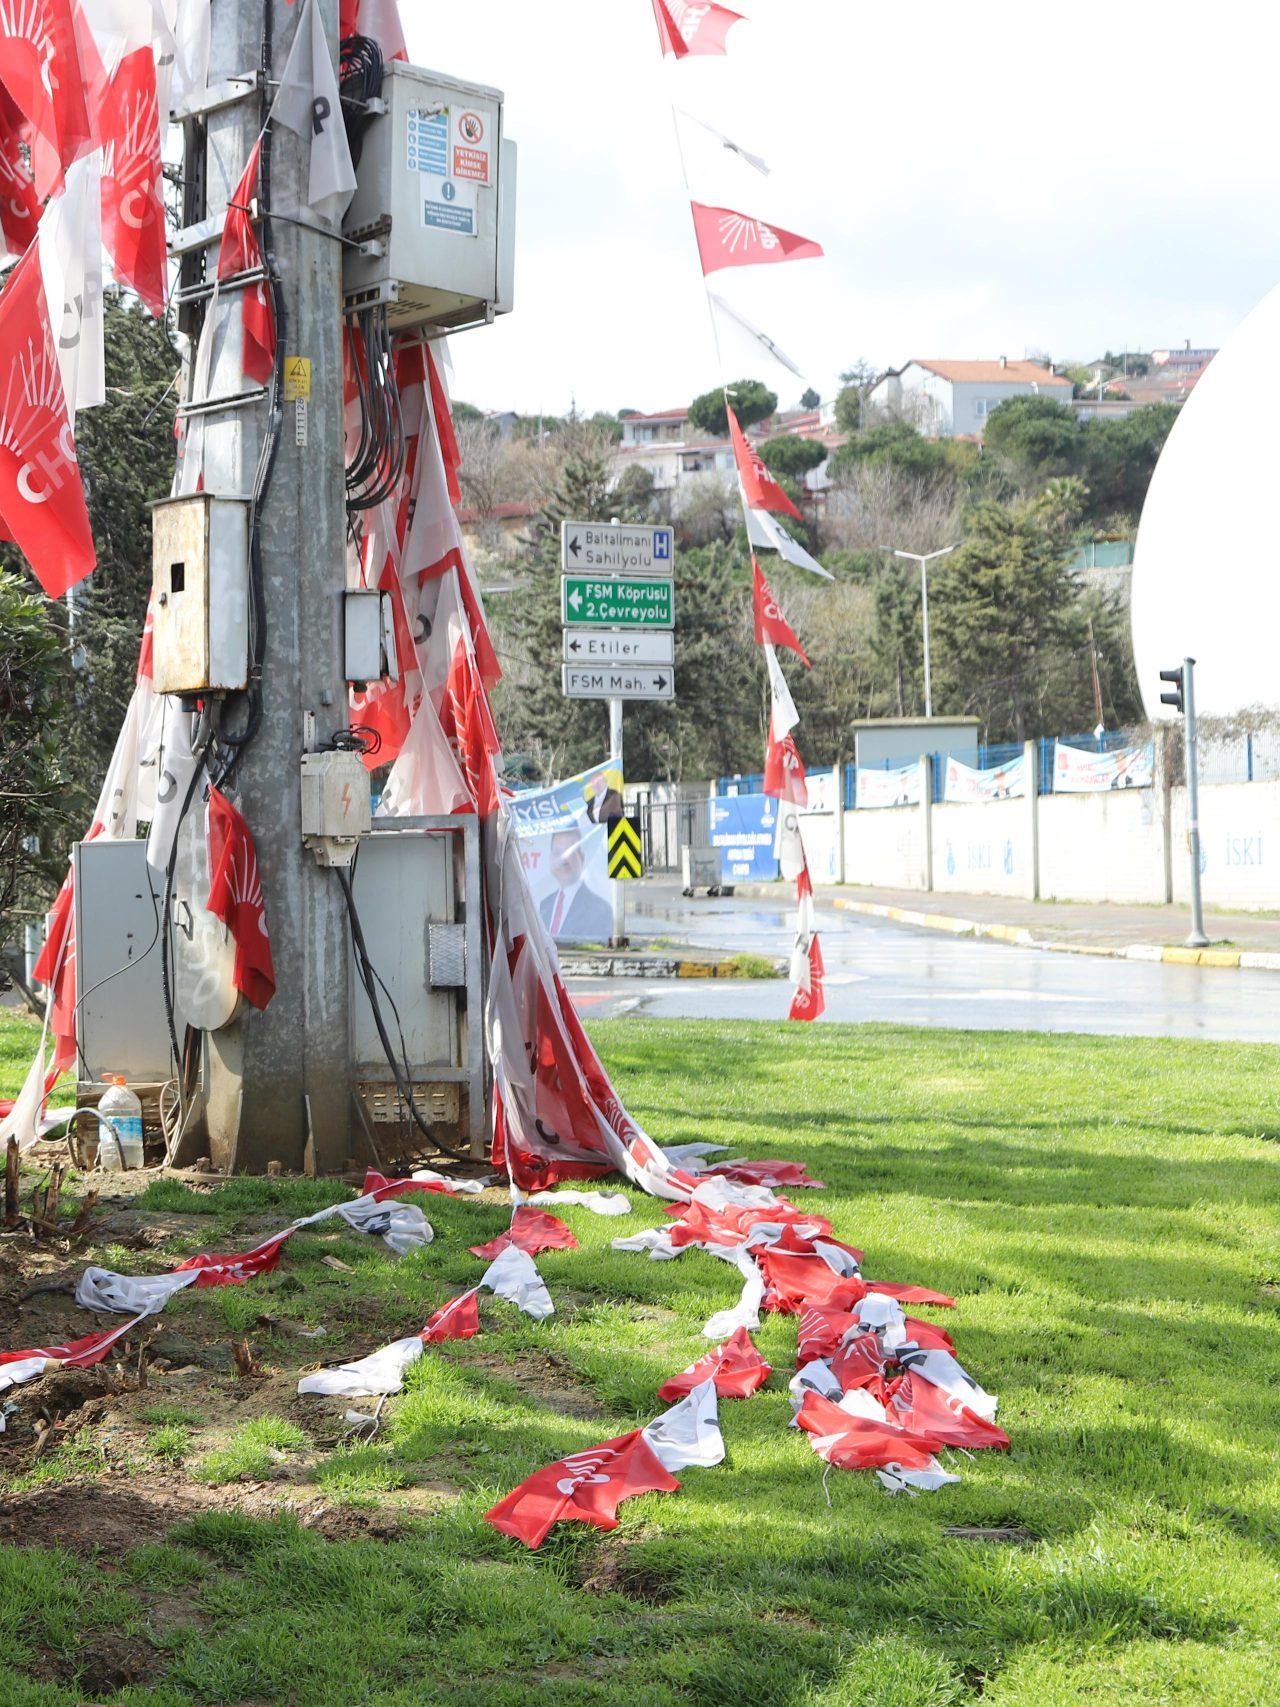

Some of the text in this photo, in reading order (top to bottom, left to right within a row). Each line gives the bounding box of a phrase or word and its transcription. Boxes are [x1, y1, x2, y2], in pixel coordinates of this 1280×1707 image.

[586, 531, 651, 548] Baltalimanı
[586, 552, 652, 569] Sahilyolu
[585, 584, 668, 604] FSM Köprüsü
[585, 602, 668, 622] 2.Çevreyolu
[588, 640, 640, 655] Etiler
[571, 675, 646, 690] FSM Mah.
